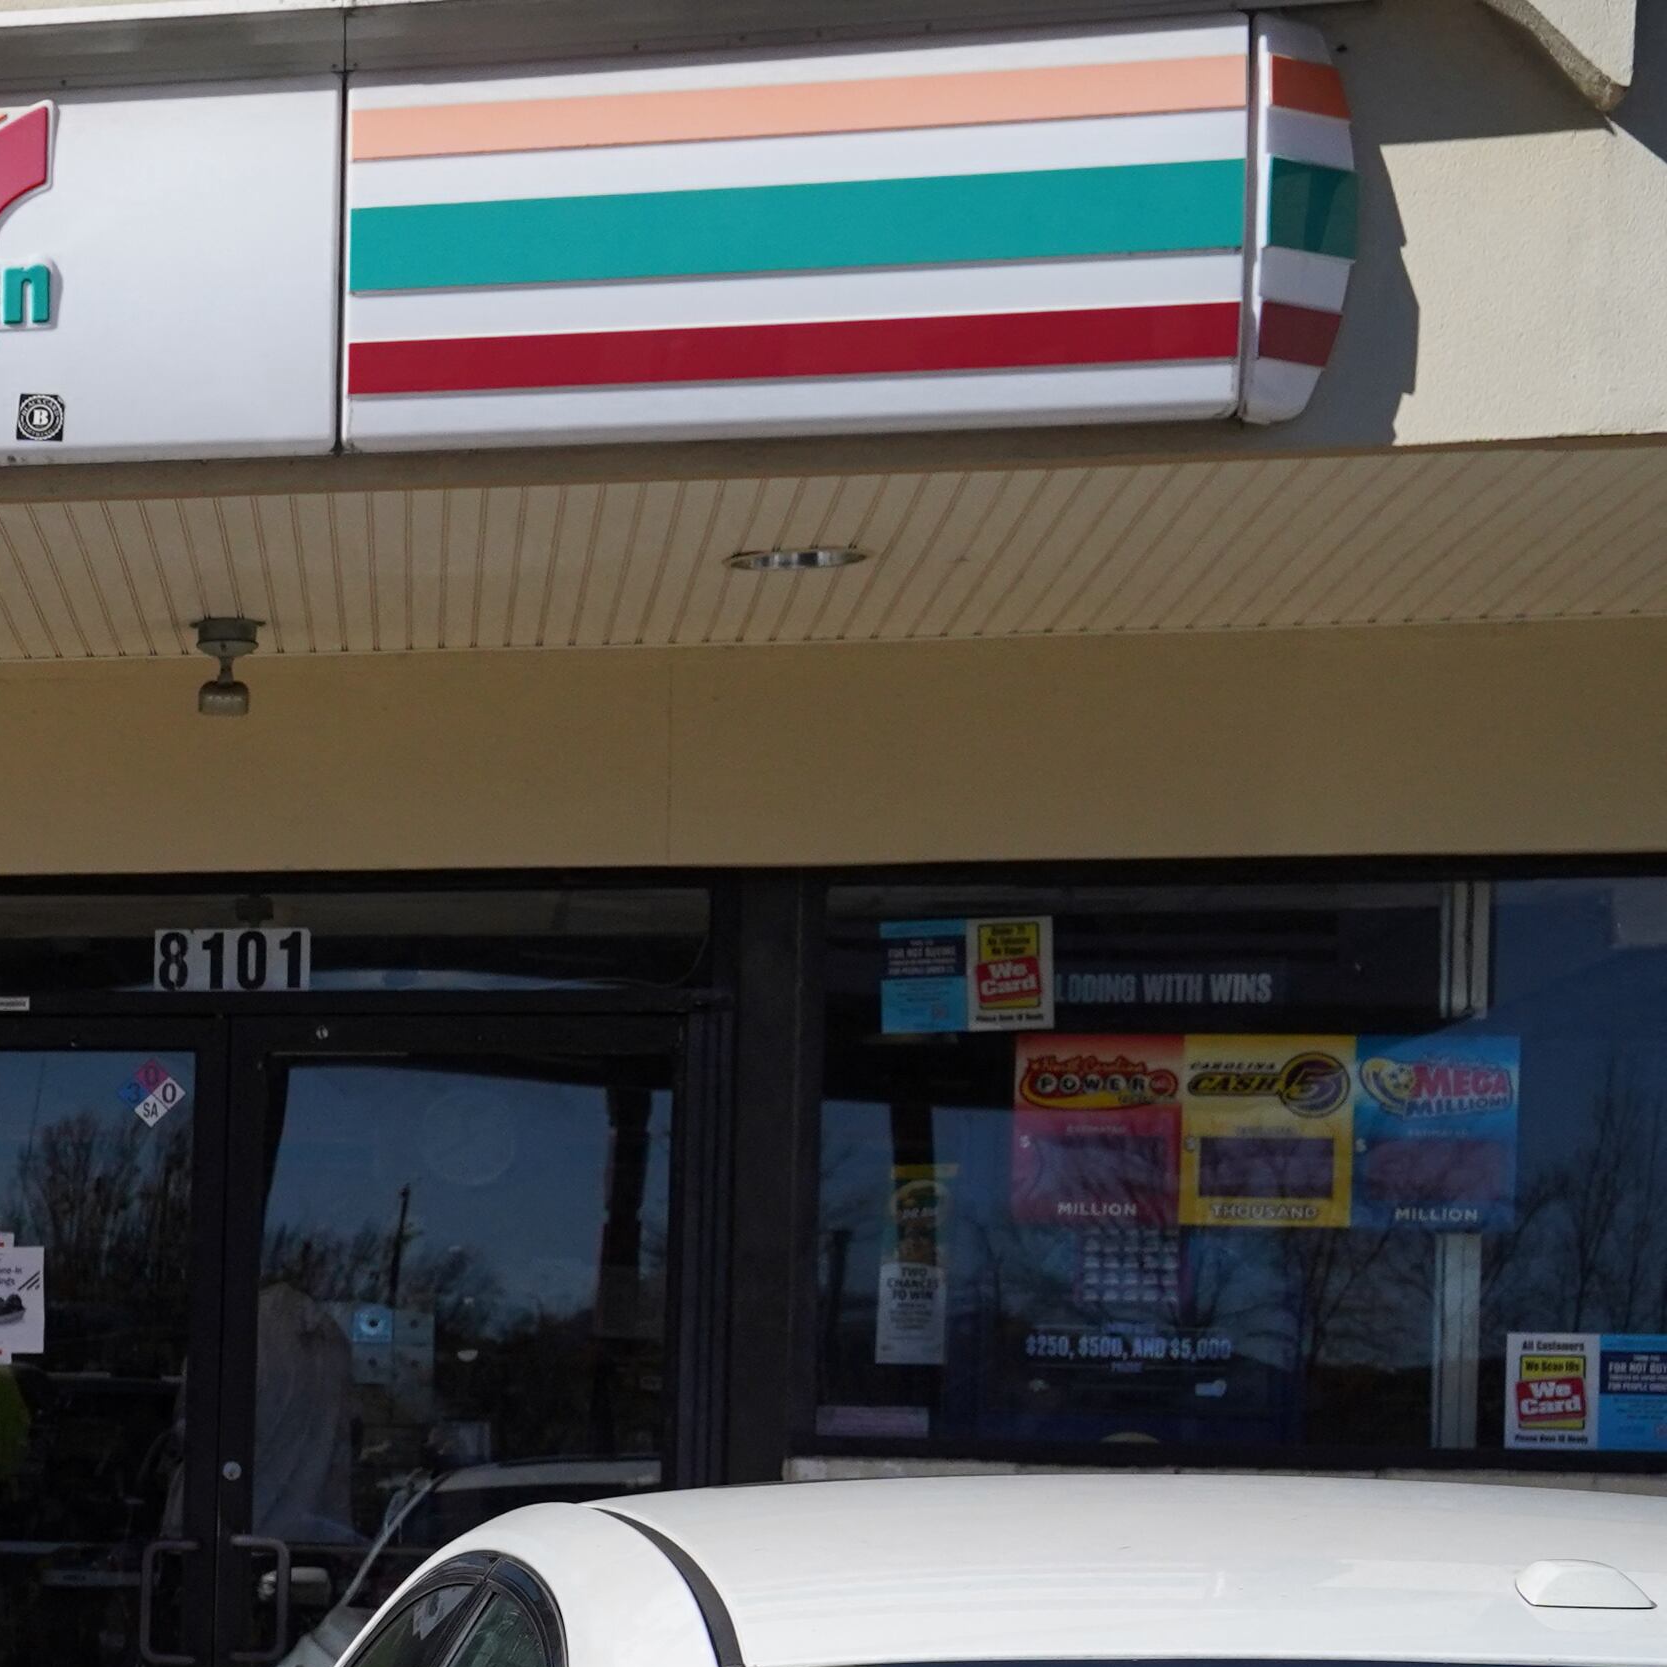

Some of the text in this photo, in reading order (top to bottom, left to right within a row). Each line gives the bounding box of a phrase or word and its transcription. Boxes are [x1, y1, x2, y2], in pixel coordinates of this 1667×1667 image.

[157, 930, 308, 990] 8101
[988, 961, 1028, 978] We
[980, 972, 1036, 997] Card
[1142, 972, 1204, 1003] WITH
[1209, 973, 1273, 1003] WINS
[1038, 1074, 1147, 1092] POWER
[1410, 1064, 1509, 1099] MEGA
[162, 1082, 177, 1104] 0
[142, 1101, 159, 1119] SA
[1057, 1201, 1137, 1216] MILLION
[1210, 1204, 1319, 1220] THOUSAND
[1394, 1207, 1479, 1222] MILLION
[1529, 1380, 1573, 1399] We
[1520, 1393, 1582, 1416] Card
